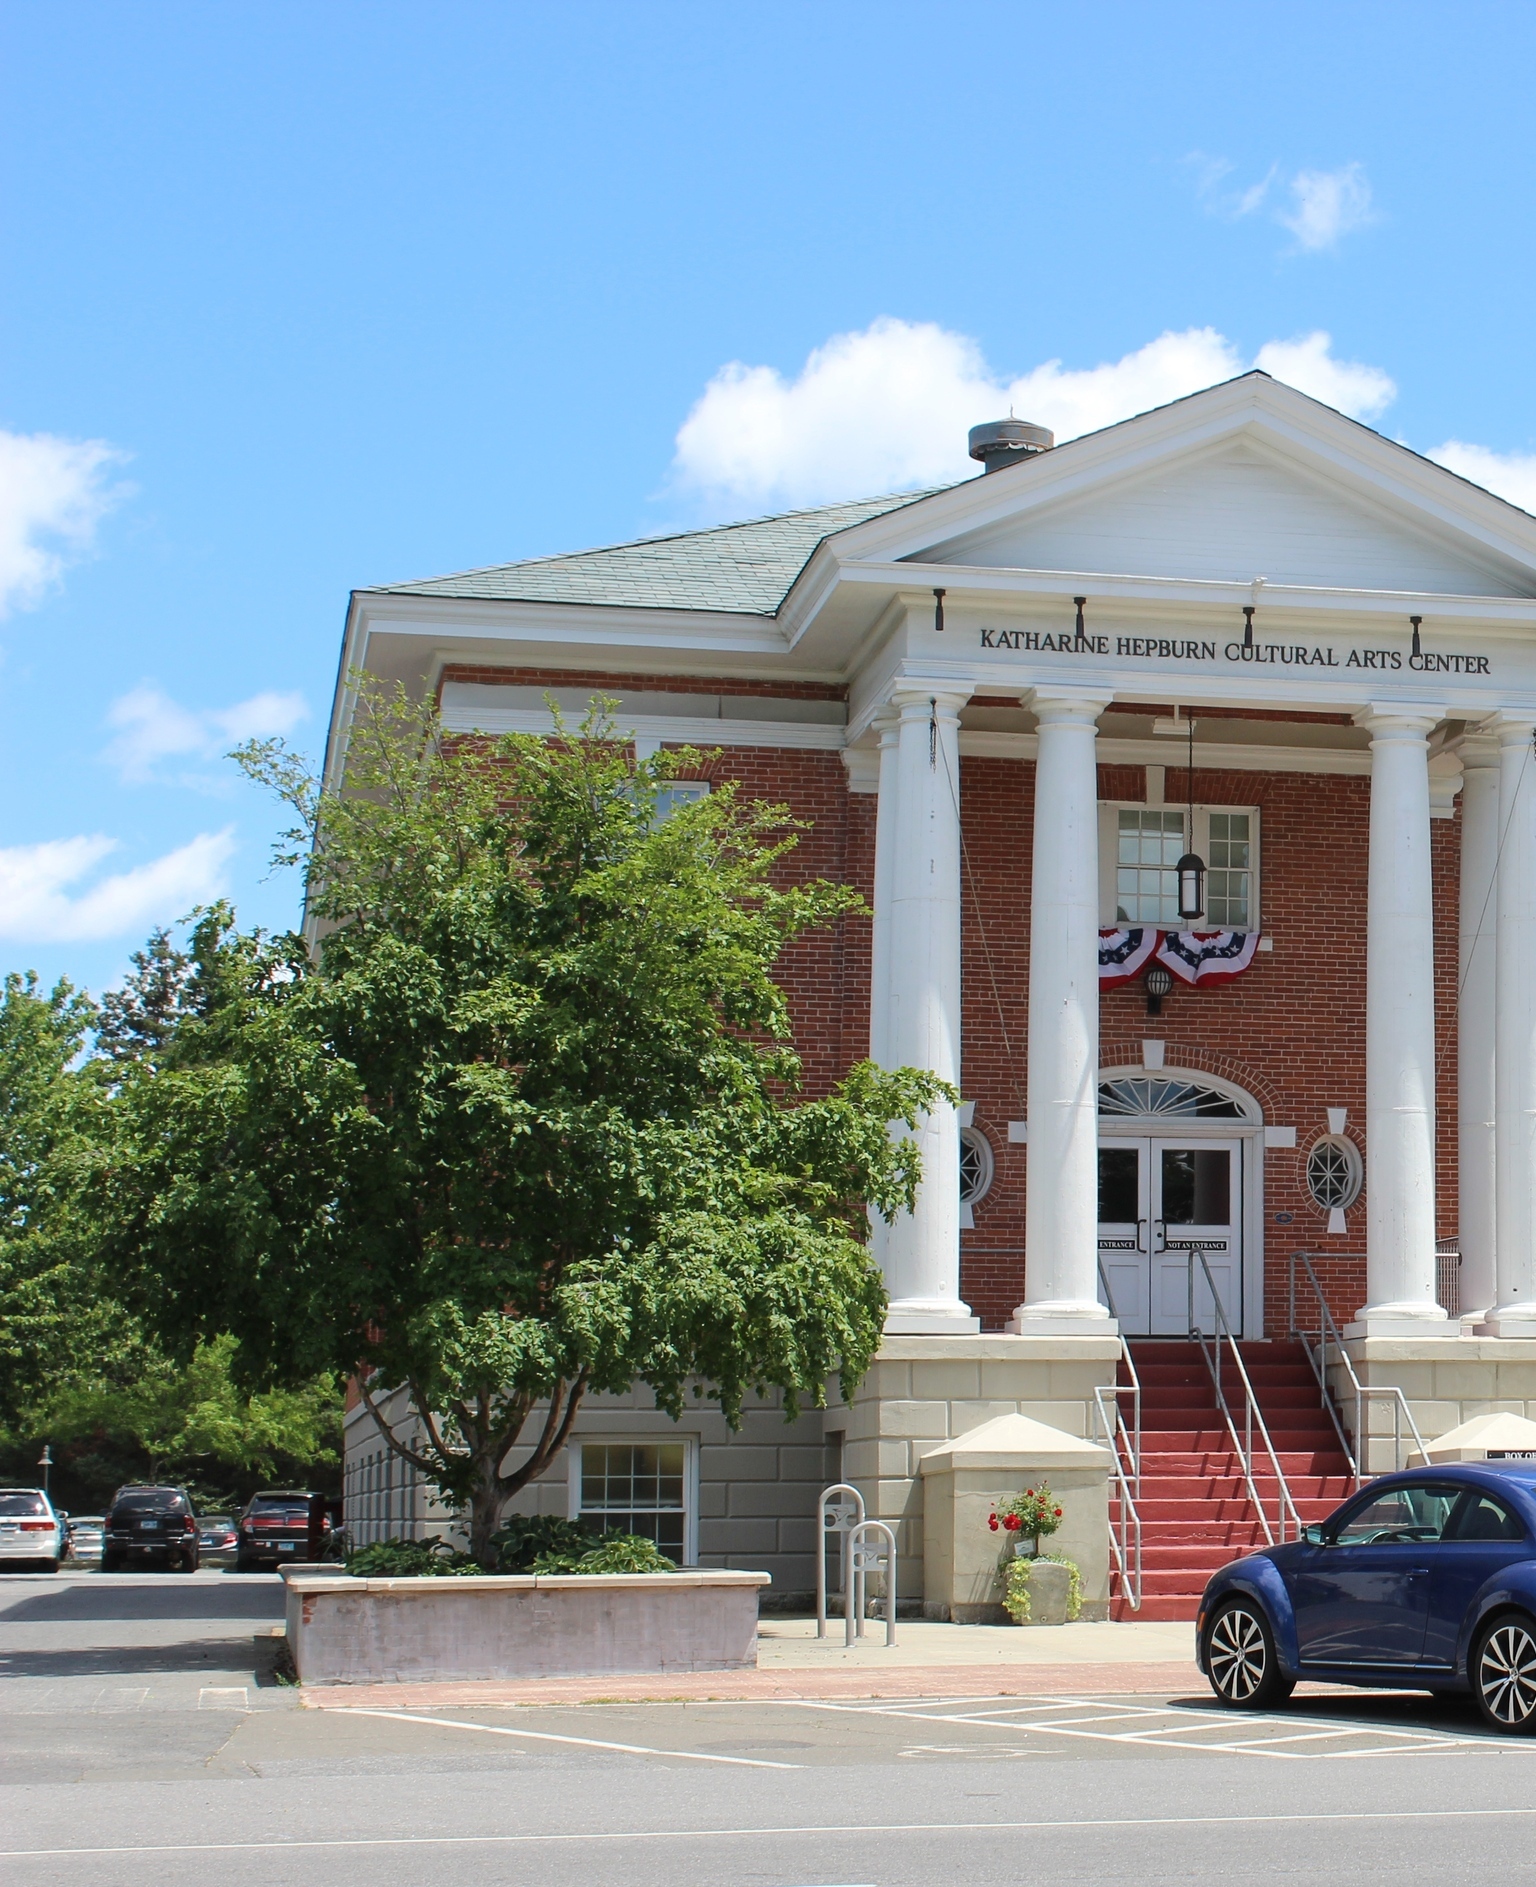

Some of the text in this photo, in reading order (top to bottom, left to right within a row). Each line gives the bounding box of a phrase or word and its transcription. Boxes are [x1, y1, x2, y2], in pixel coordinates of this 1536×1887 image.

[980, 629, 1491, 674] KATHARINE HEPBURN CULTURAL ARTS CENTER
[1191, 1242, 1226, 1250] ENTRANCE
[1504, 1452, 1523, 1460] BOX
